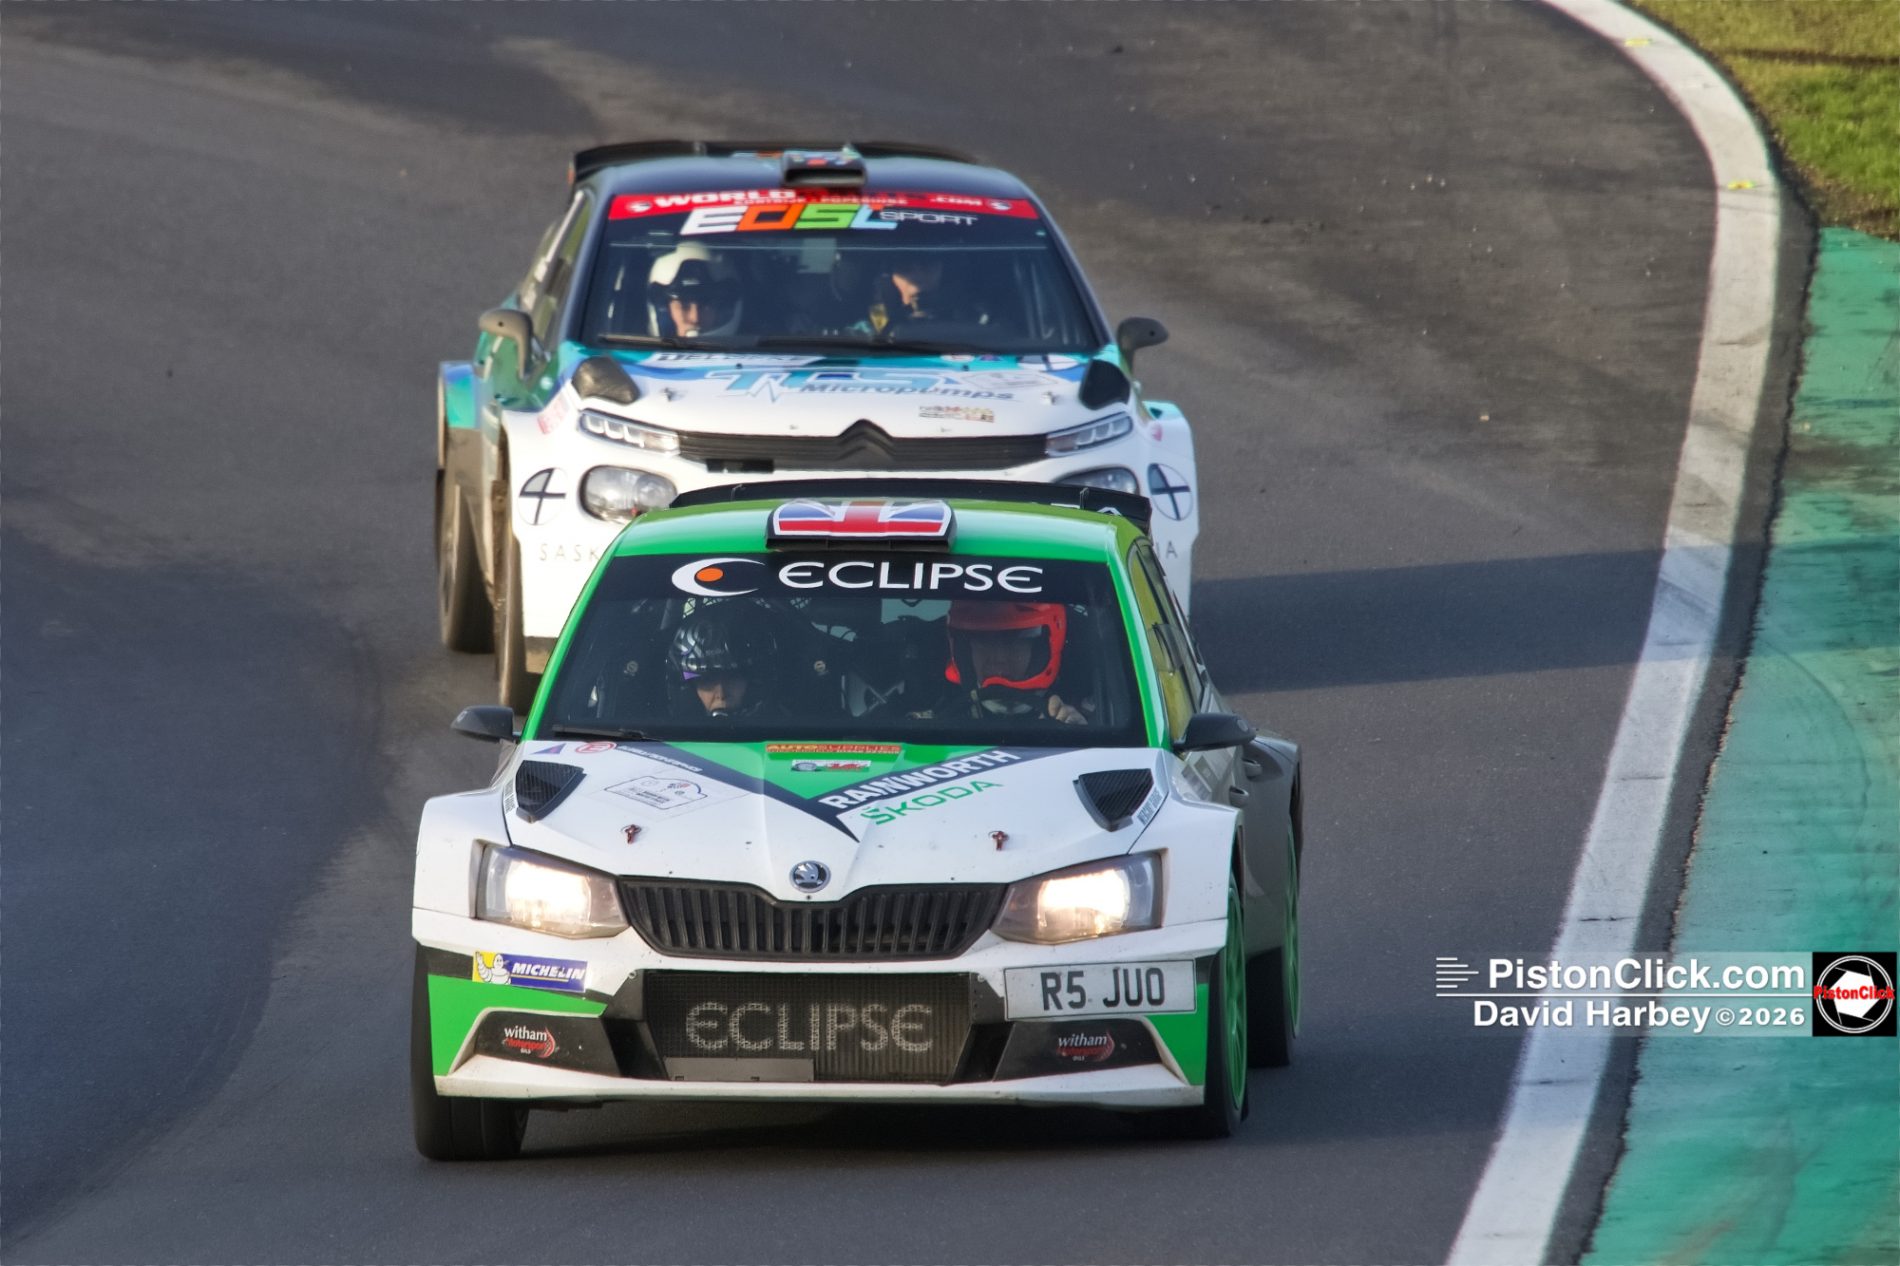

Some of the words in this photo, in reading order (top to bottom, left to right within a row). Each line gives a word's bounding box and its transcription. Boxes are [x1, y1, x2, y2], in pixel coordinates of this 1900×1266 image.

[654, 188, 797, 208] WORLD
[879, 210, 979, 225] SPORT
[800, 382, 1016, 401] Micropumps
[778, 561, 1043, 593] ECLIPSE
[818, 749, 1022, 810] RAINWORTH
[860, 779, 1004, 825] ŠKODA
[511, 962, 587, 981] MICHELIN
[1040, 971, 1087, 1012] R5
[1103, 966, 1166, 1008] JUO
[504, 1025, 548, 1041] witham
[685, 1002, 934, 1051] ECLIPSE
[1058, 1032, 1108, 1048] witham
